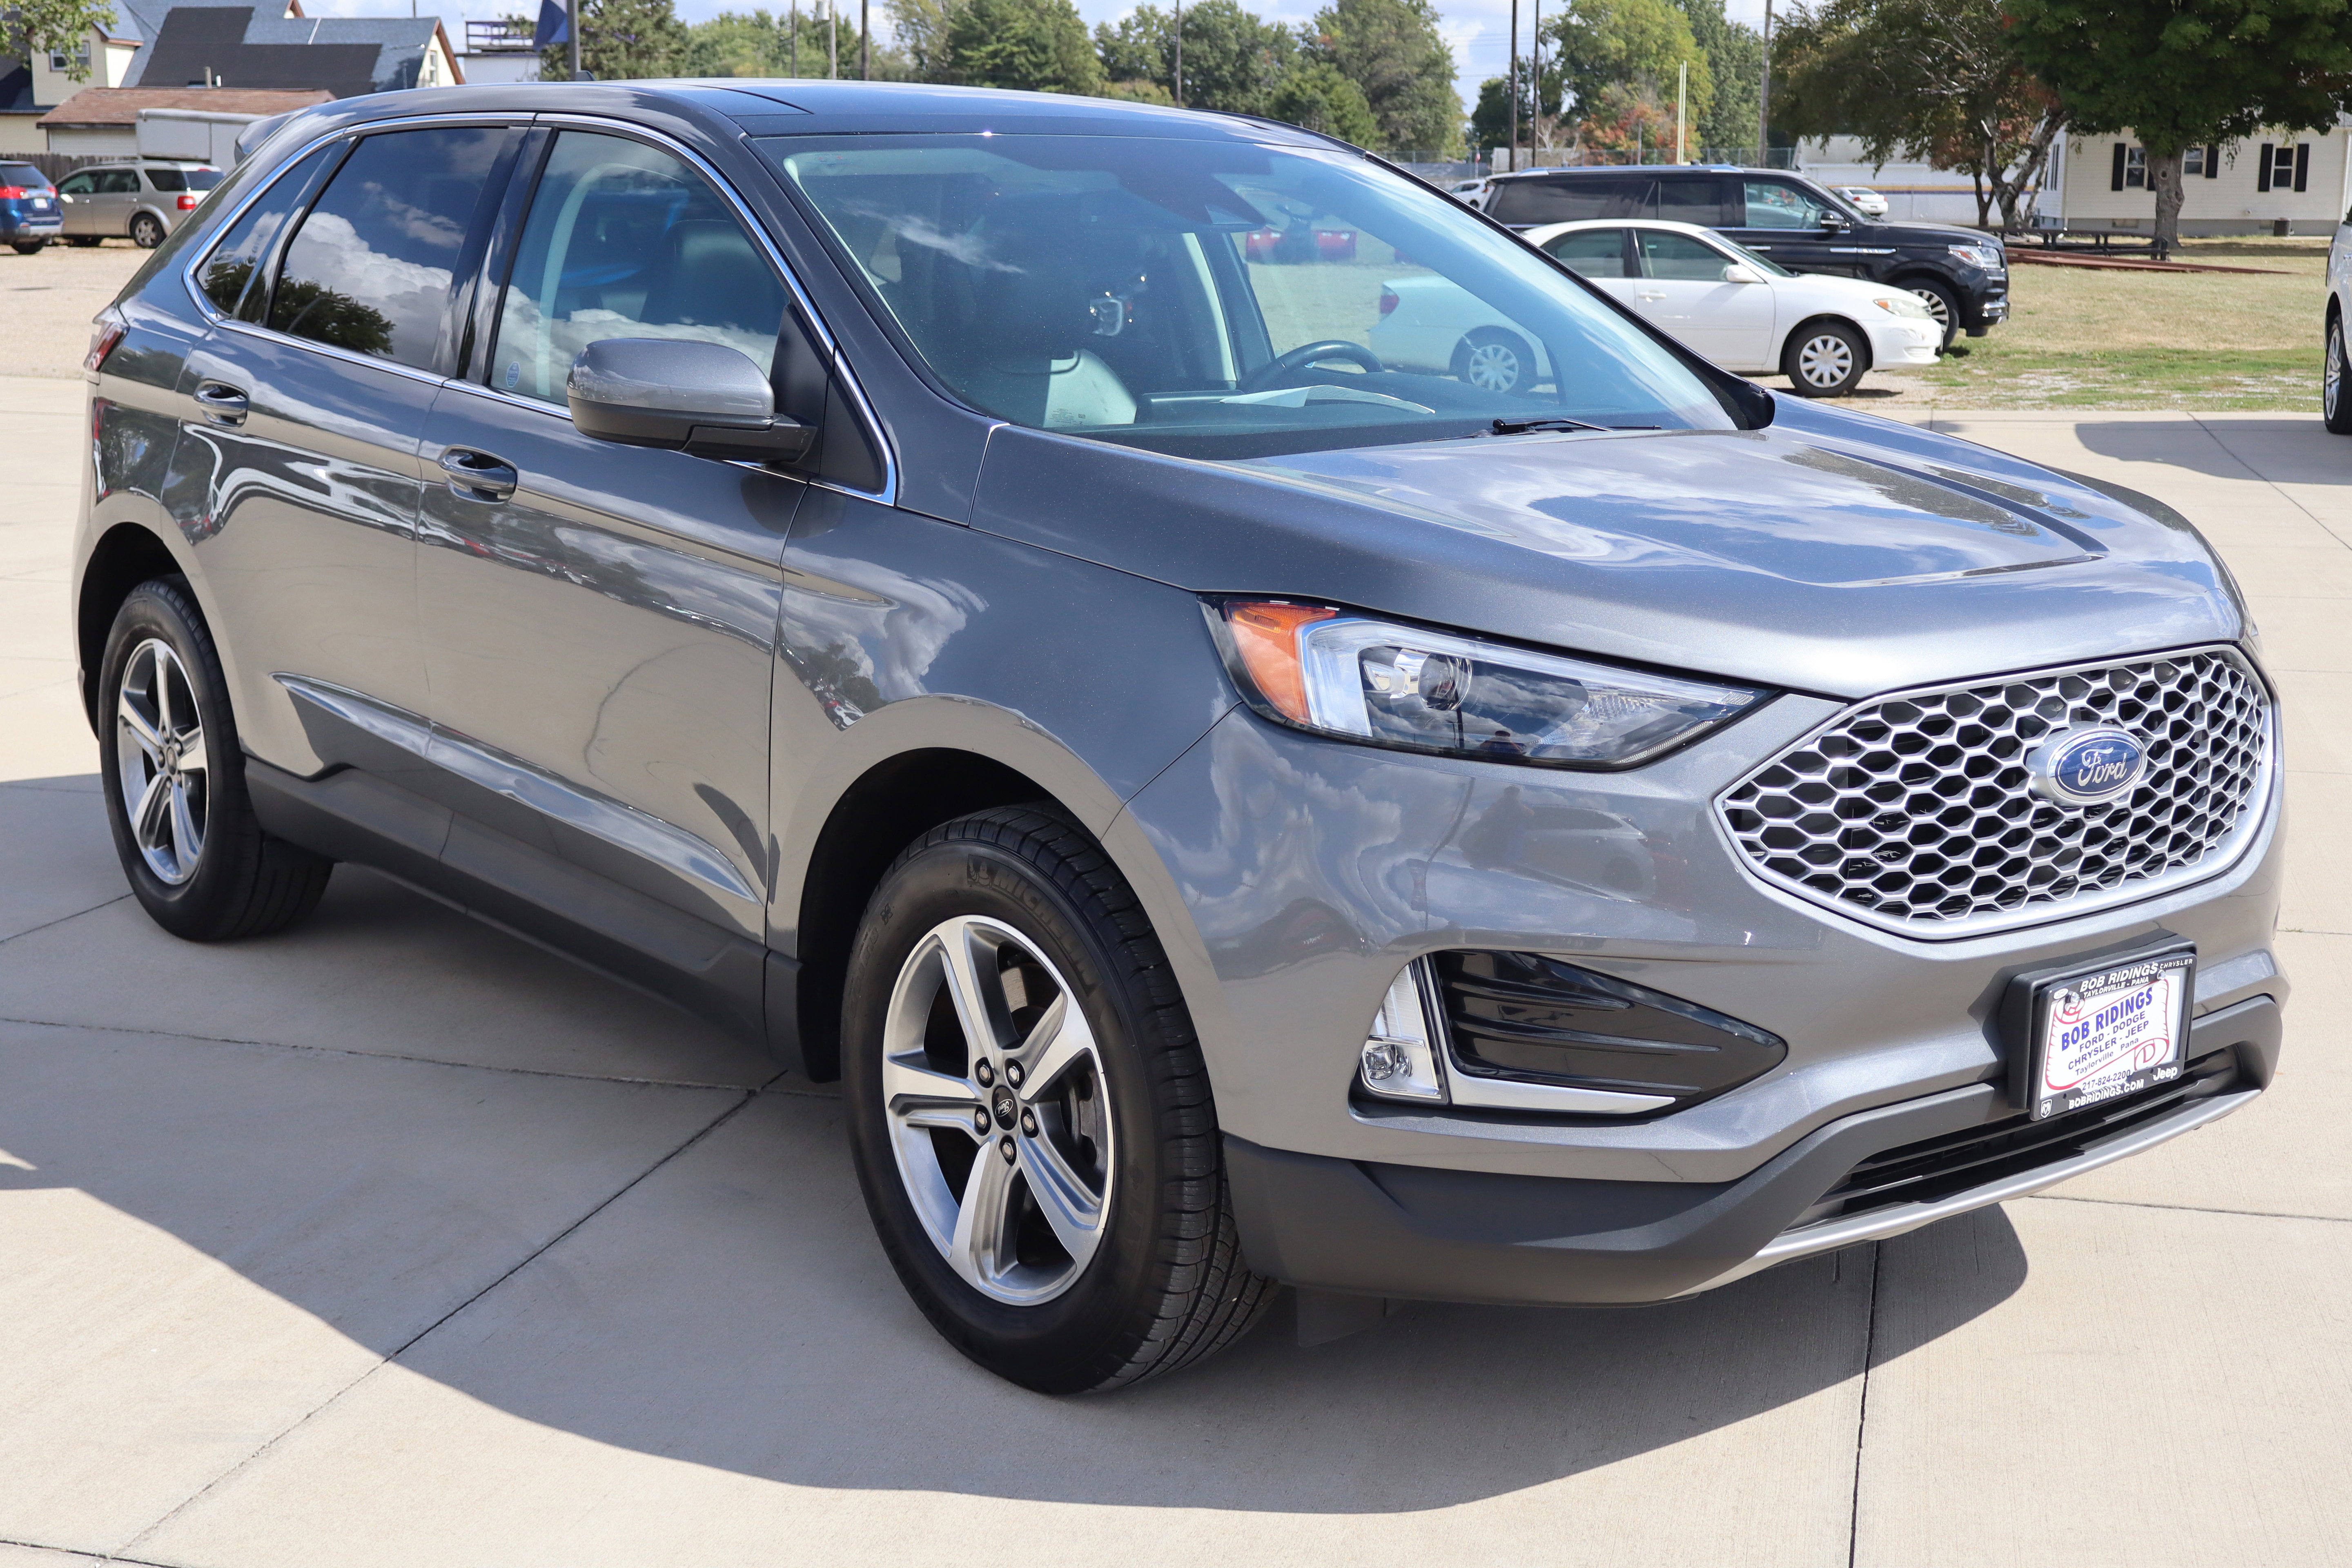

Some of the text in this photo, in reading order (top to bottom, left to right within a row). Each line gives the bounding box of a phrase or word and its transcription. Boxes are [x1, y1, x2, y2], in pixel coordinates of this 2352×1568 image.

[2078, 747, 2127, 786] Ford
[994, 869, 1101, 986] MICHELIN
[2080, 962, 2158, 992] BOB RIDINGS
[2160, 959, 2193, 969] CHRYSLER
[2083, 982, 2126, 998] TAYLORVILLE
[2131, 976, 2149, 986] PANA
[2062, 987, 2153, 1051] BOB RIDINGS
[2080, 1033, 2104, 1053] FORD
[2113, 1011, 2145, 1034] DODGE
[2068, 1037, 2117, 1070] CHRYSLER
[2125, 1020, 2149, 1038] JEEP
[2075, 1038, 2139, 1076] Taylorville Pana
[2082, 1069, 2130, 1091] 217-824-2200
[2152, 1067, 2178, 1081] Jeep
[997, 1100, 1009, 1114] Ford
[2069, 1078, 2144, 1110] BOBRIDINGS.COM
